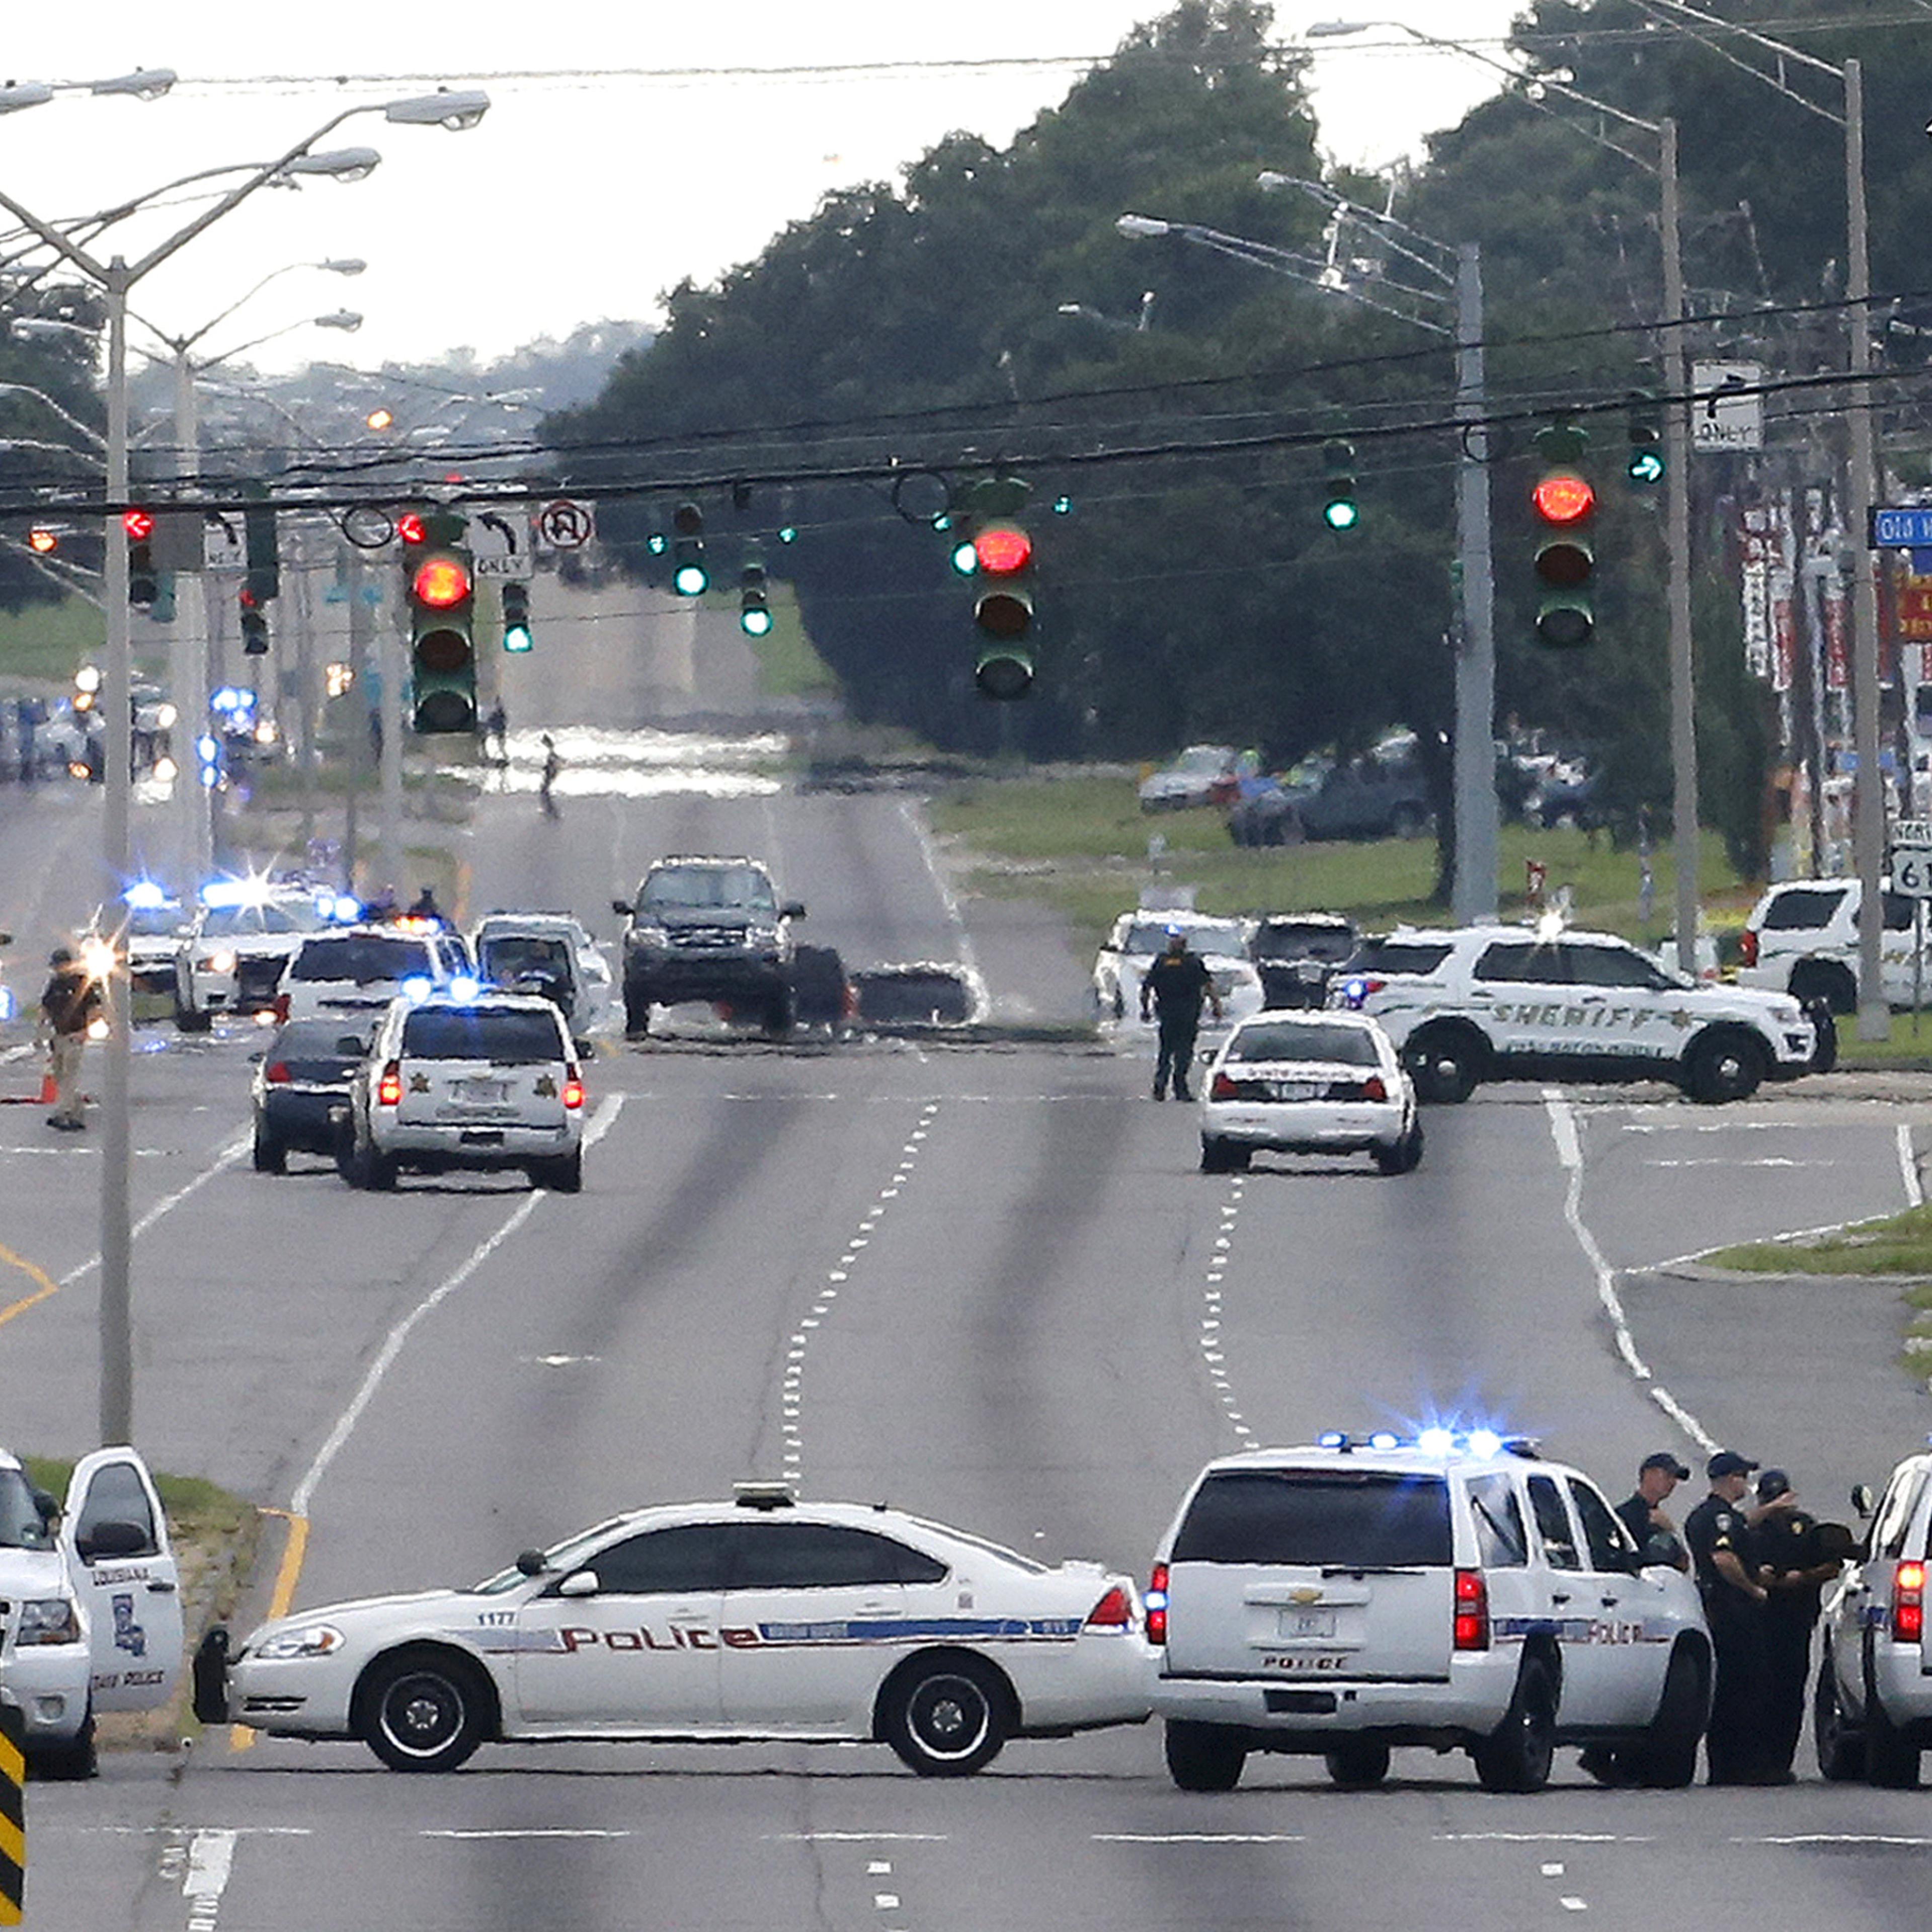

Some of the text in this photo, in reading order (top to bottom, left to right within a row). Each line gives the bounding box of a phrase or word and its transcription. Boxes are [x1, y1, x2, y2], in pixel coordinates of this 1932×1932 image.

[1901, 861, 1932, 888] 61
[1493, 1005, 1654, 1031] SHERIFF
[478, 1612, 515, 1626] 1177
[1263, 1656, 1348, 1670] POLICE
